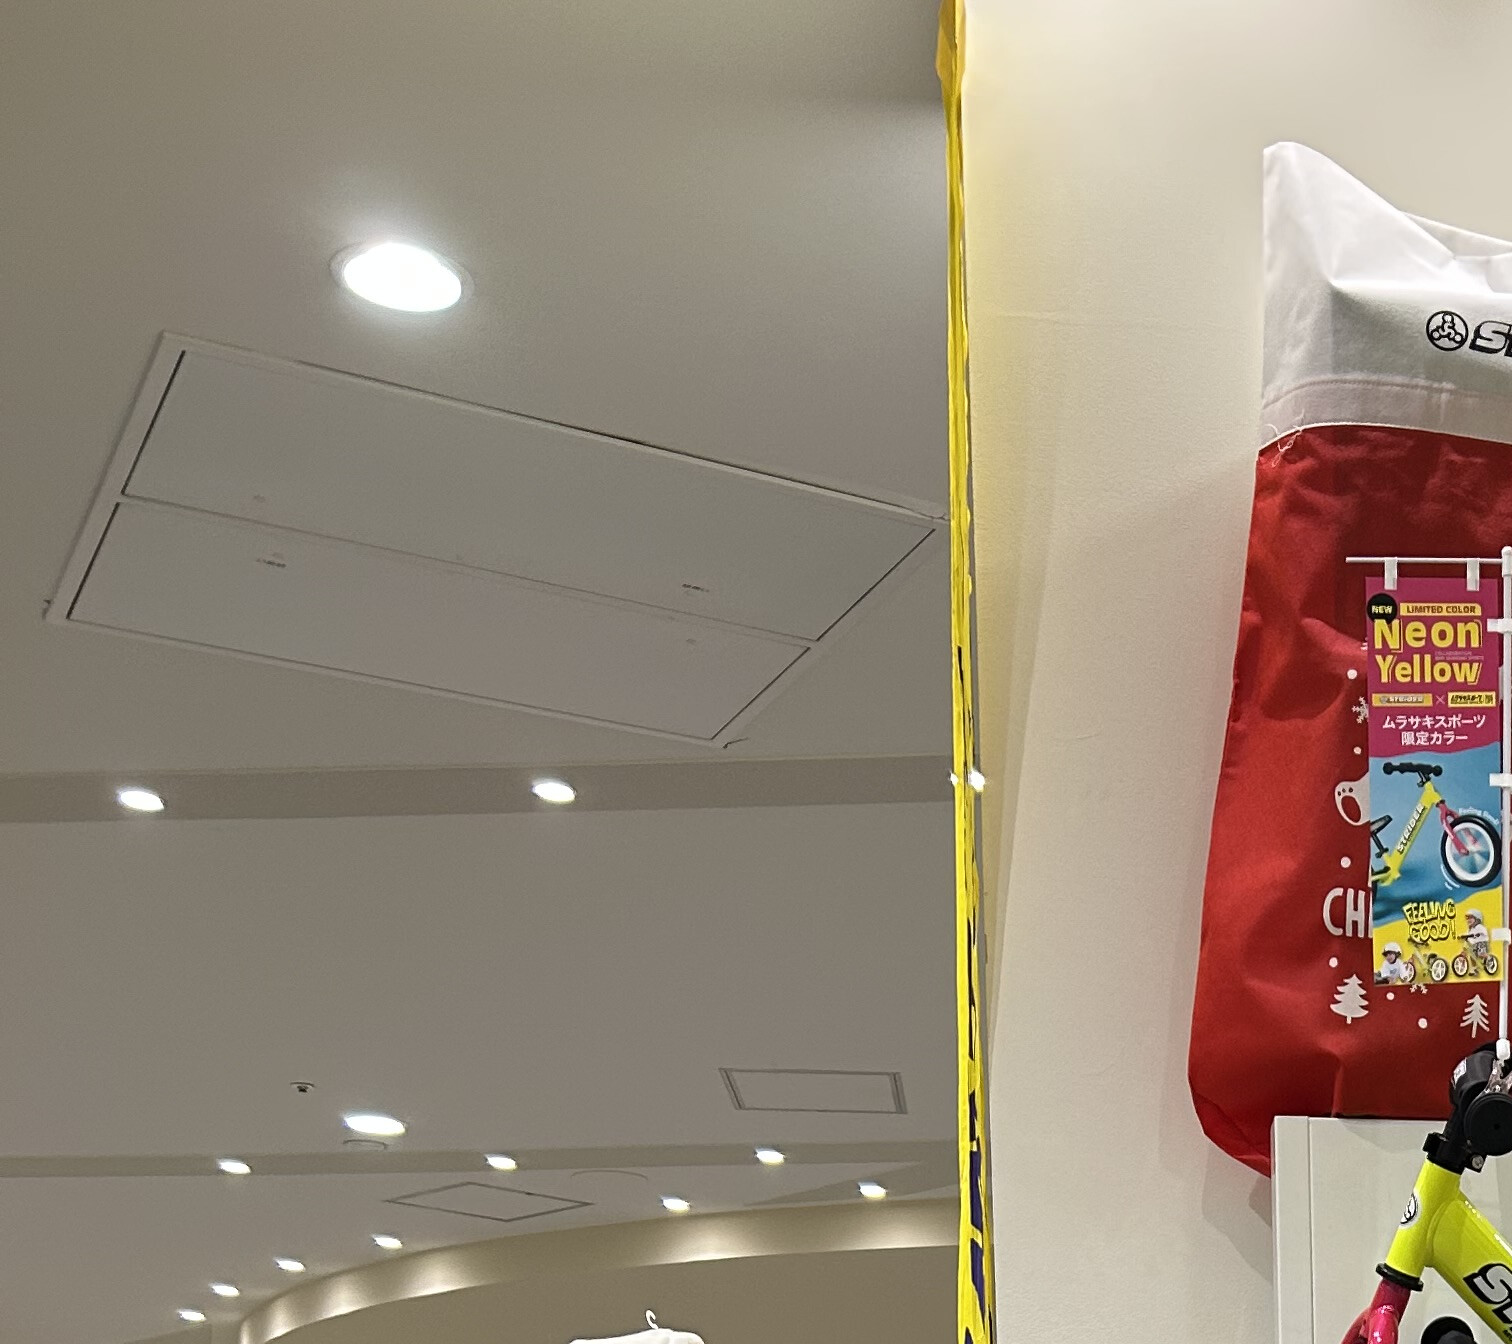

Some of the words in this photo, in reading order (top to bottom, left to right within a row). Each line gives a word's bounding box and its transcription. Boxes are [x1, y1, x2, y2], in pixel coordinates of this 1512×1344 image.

[1372, 605, 1392, 614] NEW
[1407, 605, 1442, 613] LIMITED
[1446, 605, 1476, 613] COLOR
[1374, 619, 1482, 651] Neon
[1375, 654, 1482, 685] Yellow
[1383, 715, 1486, 729] ムラサキスポーツ
[1401, 731, 1468, 746] 限定カラー
[1323, 887, 1373, 938] CH
[1402, 899, 1456, 925] FEELING
